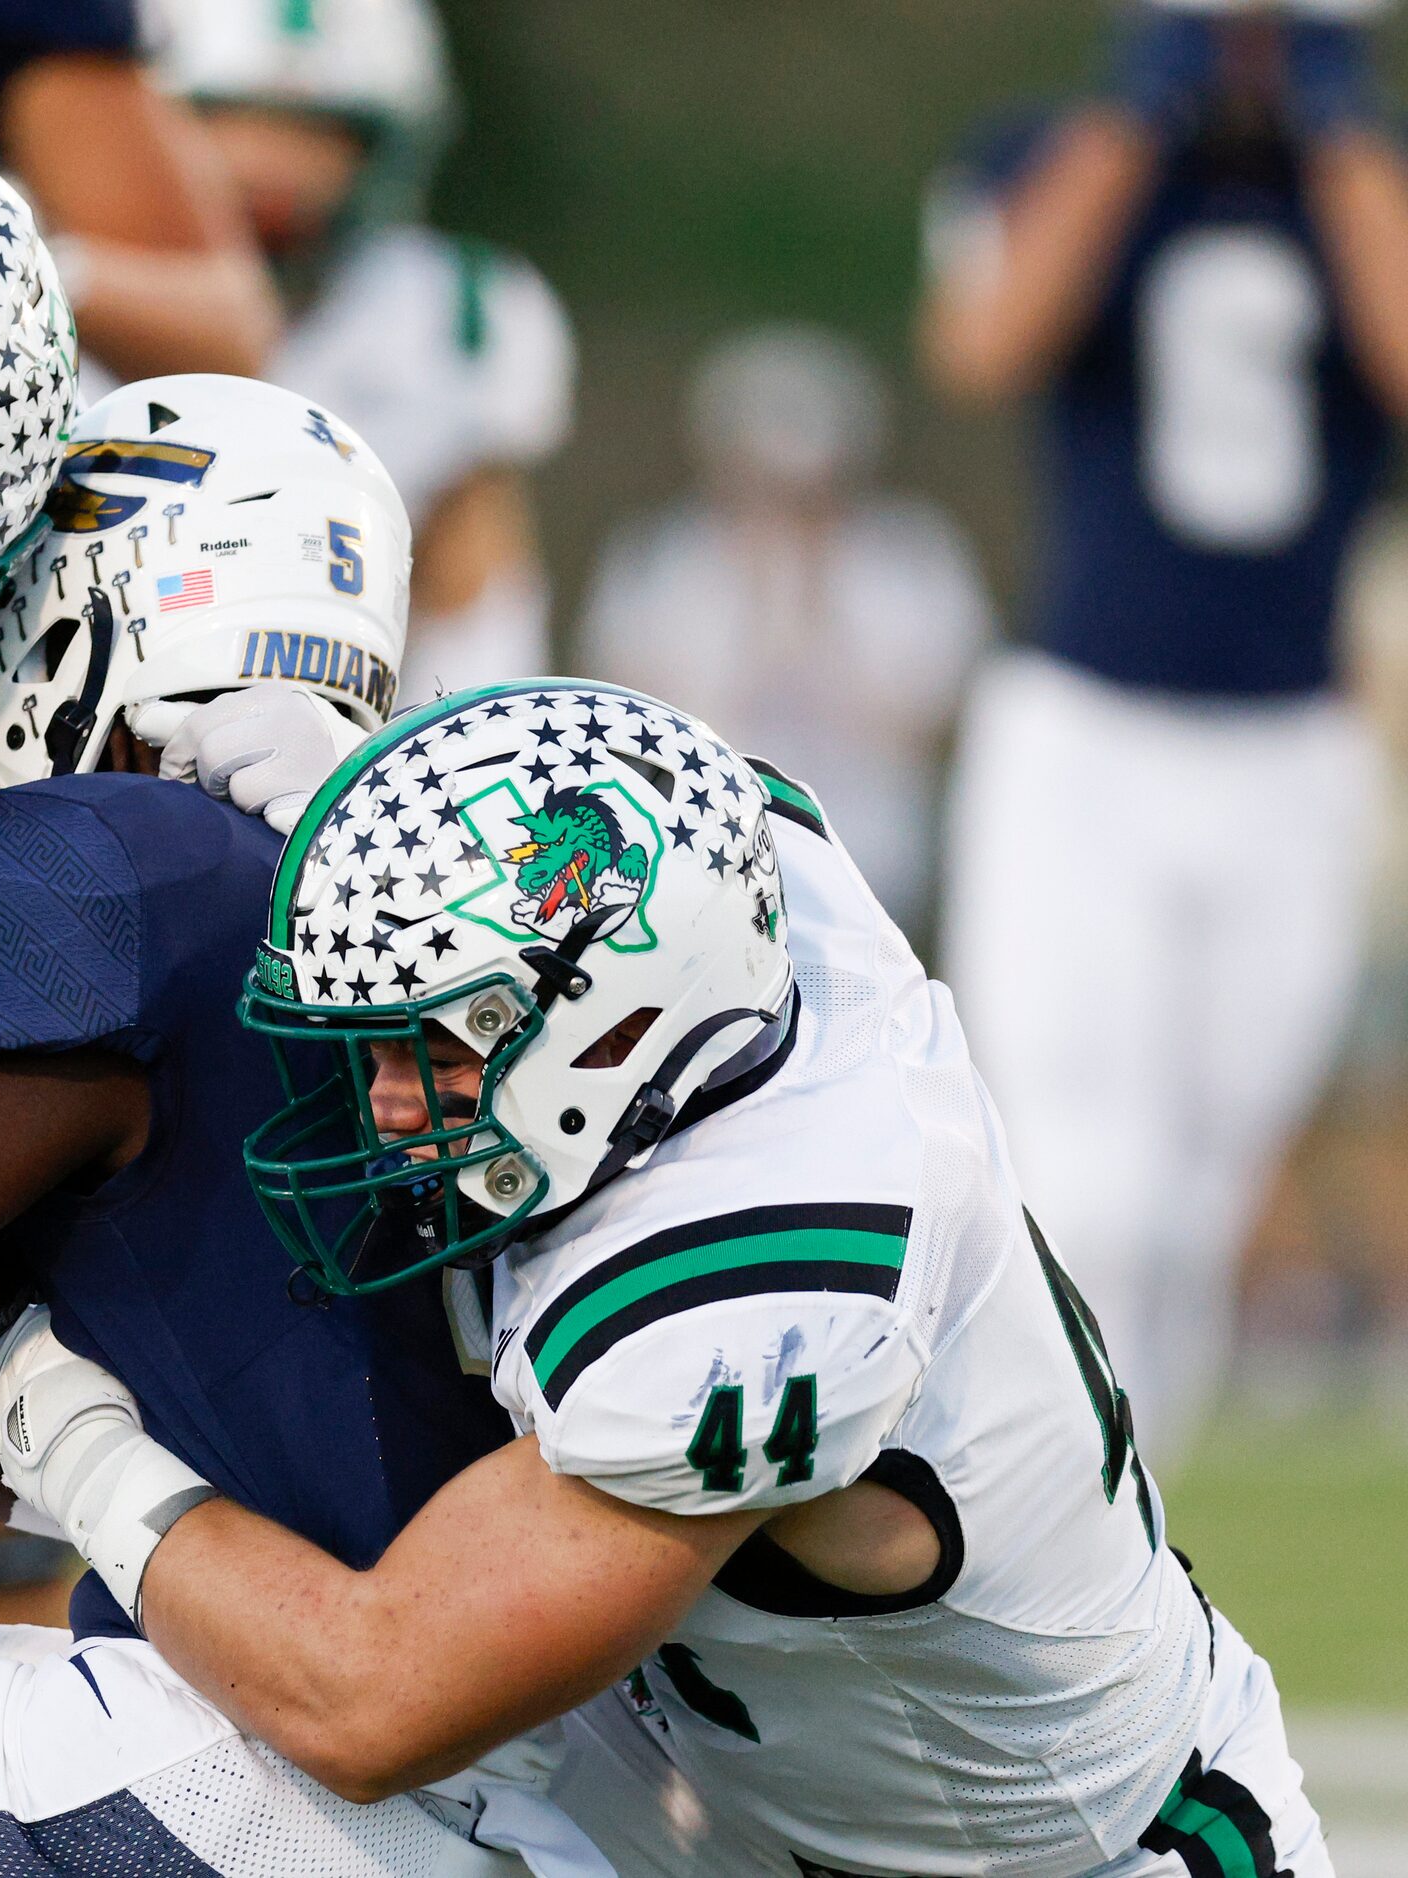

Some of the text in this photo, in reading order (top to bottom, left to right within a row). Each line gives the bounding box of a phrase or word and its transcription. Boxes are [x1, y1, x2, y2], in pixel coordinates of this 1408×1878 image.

[200, 538, 248, 552] Riddell
[326, 517, 365, 601] 5
[684, 1373, 819, 1492] 44
